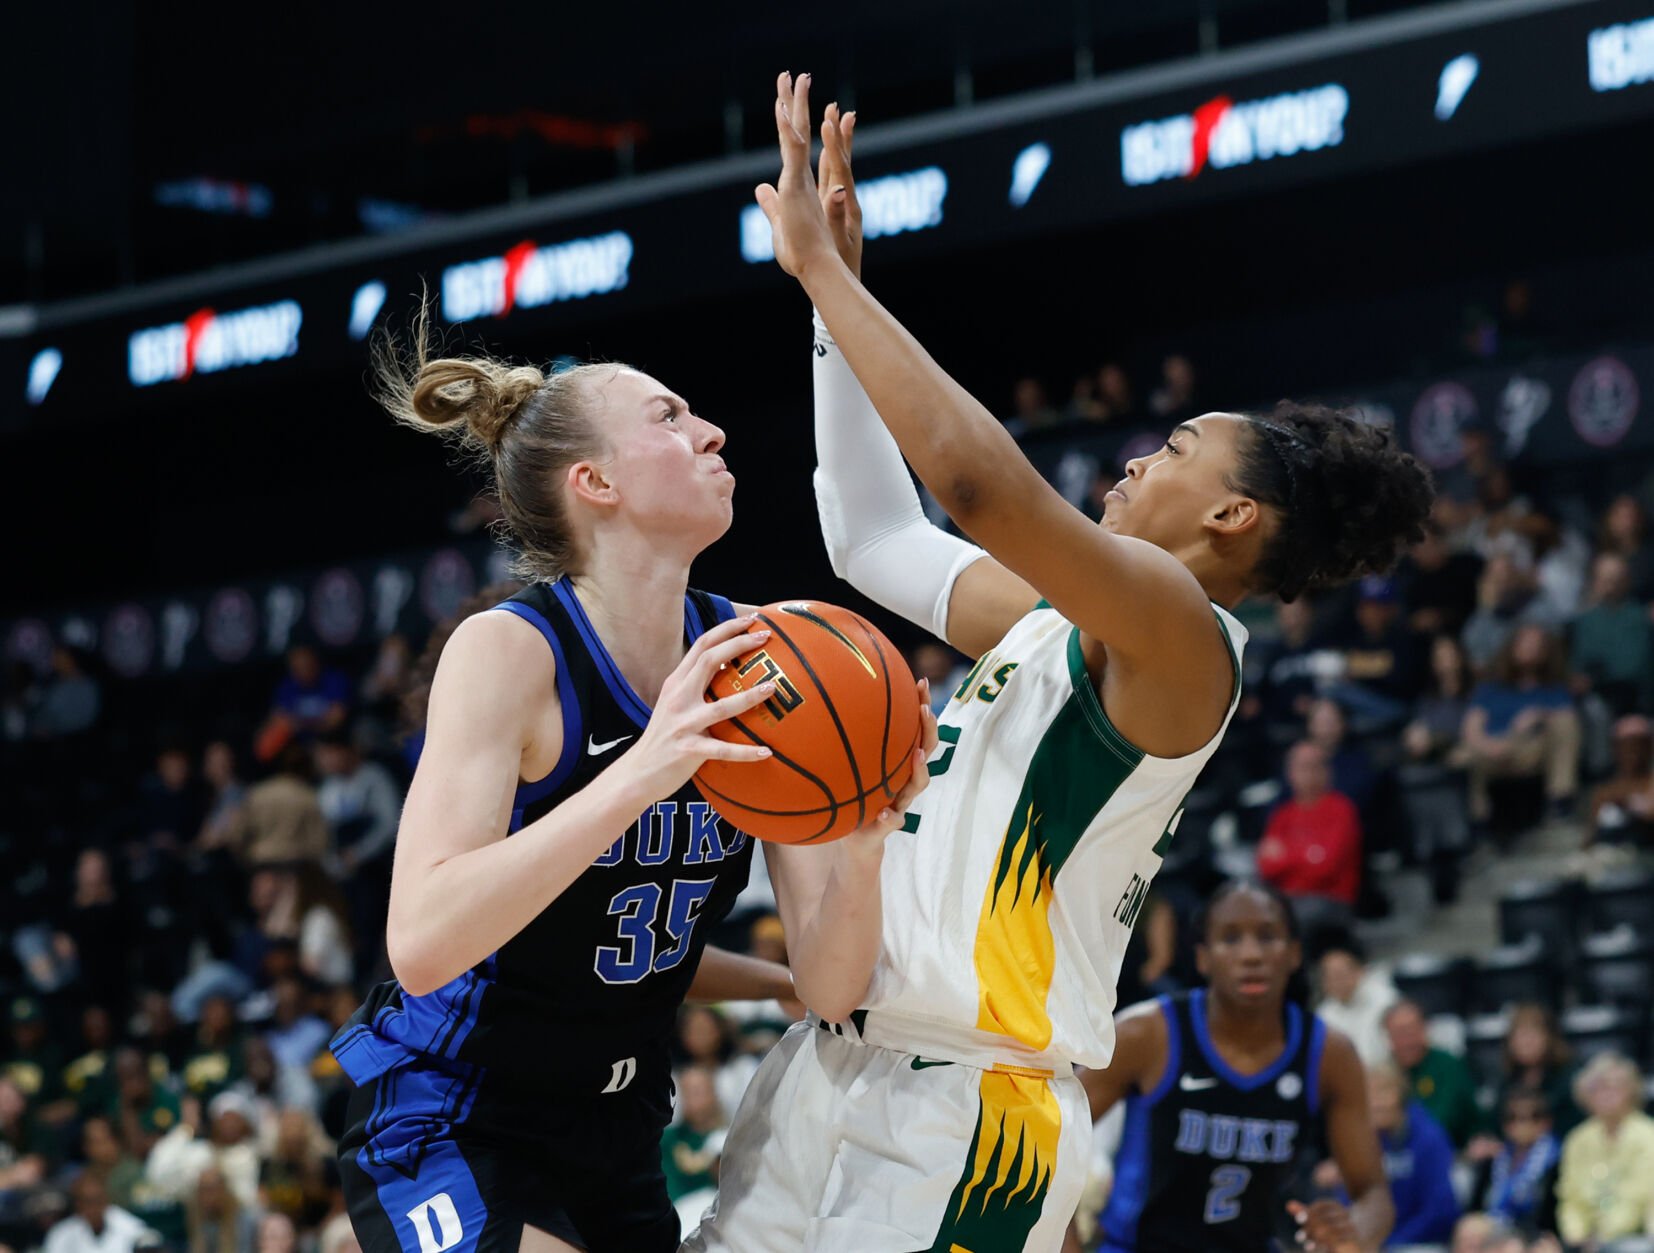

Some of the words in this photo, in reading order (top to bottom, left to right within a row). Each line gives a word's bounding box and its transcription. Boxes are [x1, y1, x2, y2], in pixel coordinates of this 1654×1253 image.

[593, 874, 718, 984] 35
[1175, 1108, 1298, 1164] DUKE
[1203, 1164, 1251, 1225] 2
